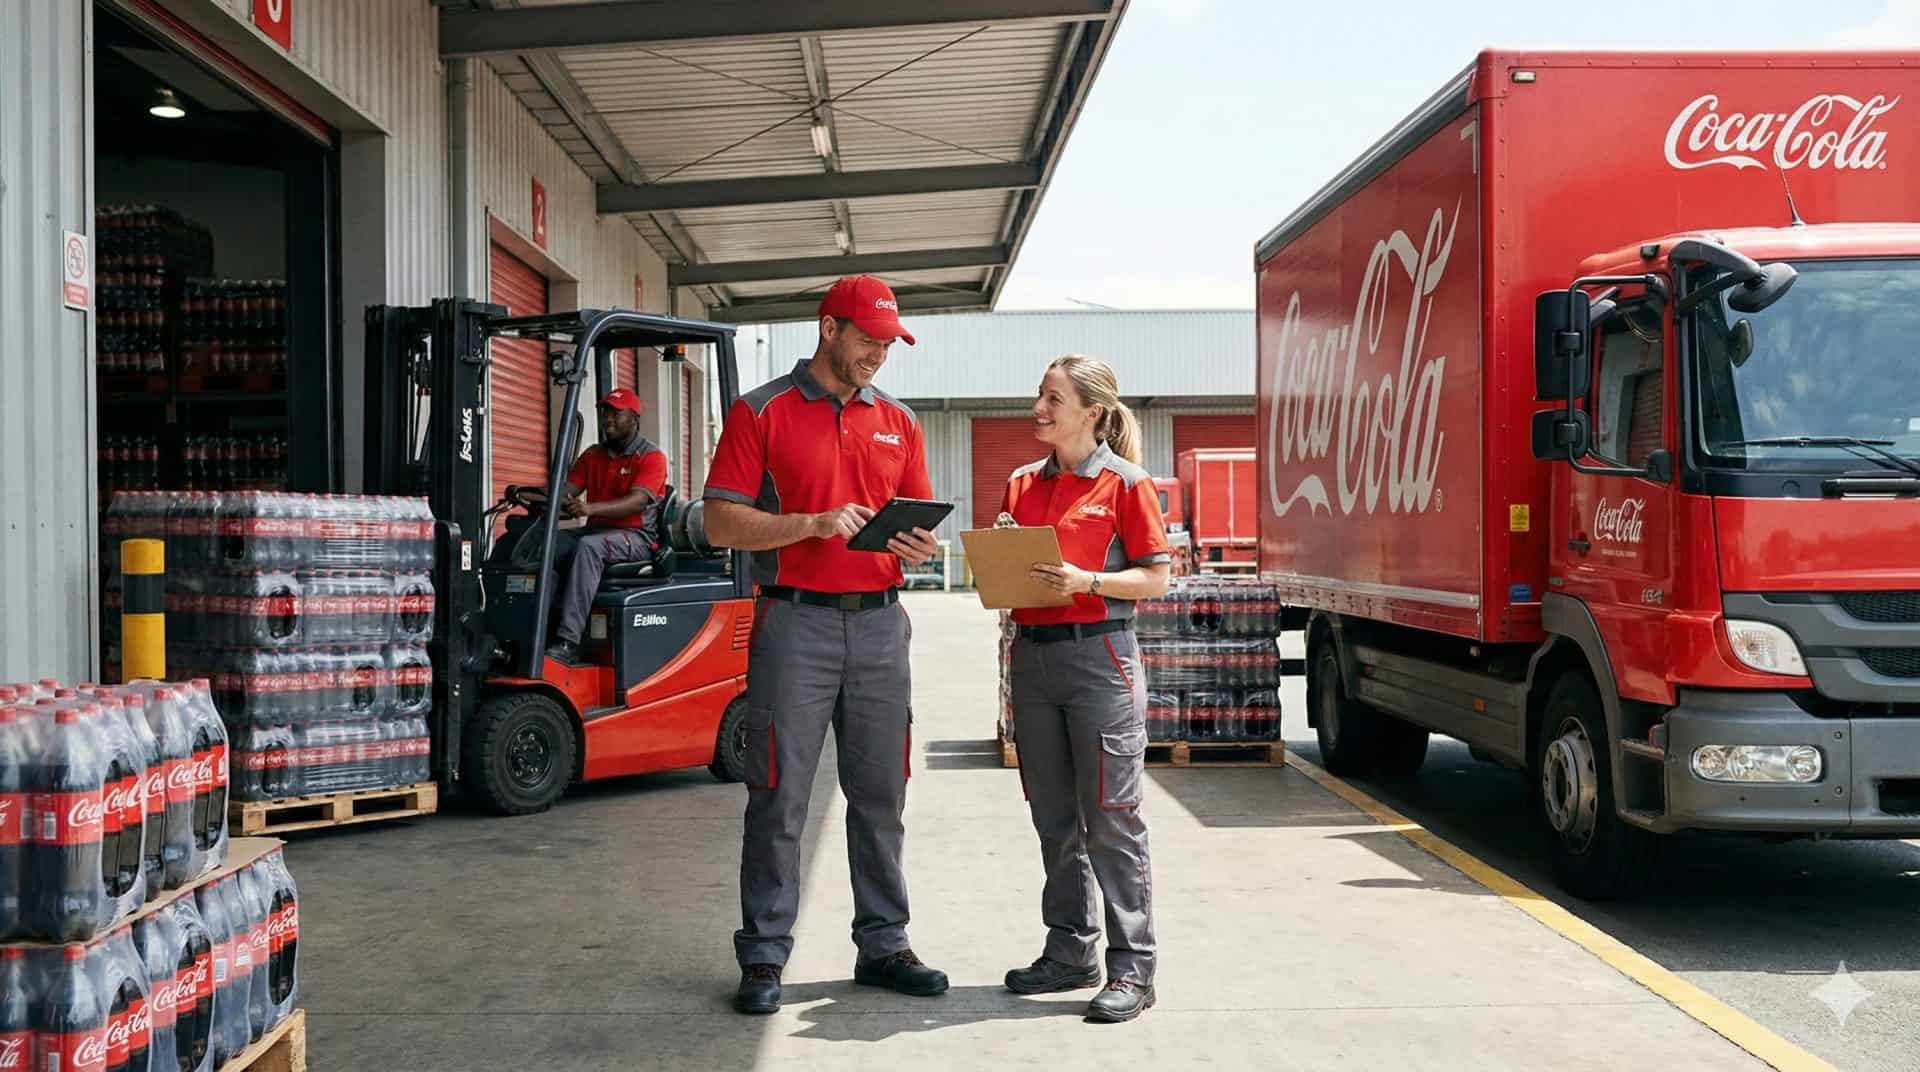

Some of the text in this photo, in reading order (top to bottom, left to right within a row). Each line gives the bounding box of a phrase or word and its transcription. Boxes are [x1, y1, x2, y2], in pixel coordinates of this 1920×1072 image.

[1664, 94, 1900, 171] Coca-Cola
[537, 193, 544, 234] 2
[1269, 191, 1462, 520] Coca-Cola
[1594, 497, 1647, 543] Coca-Cola
